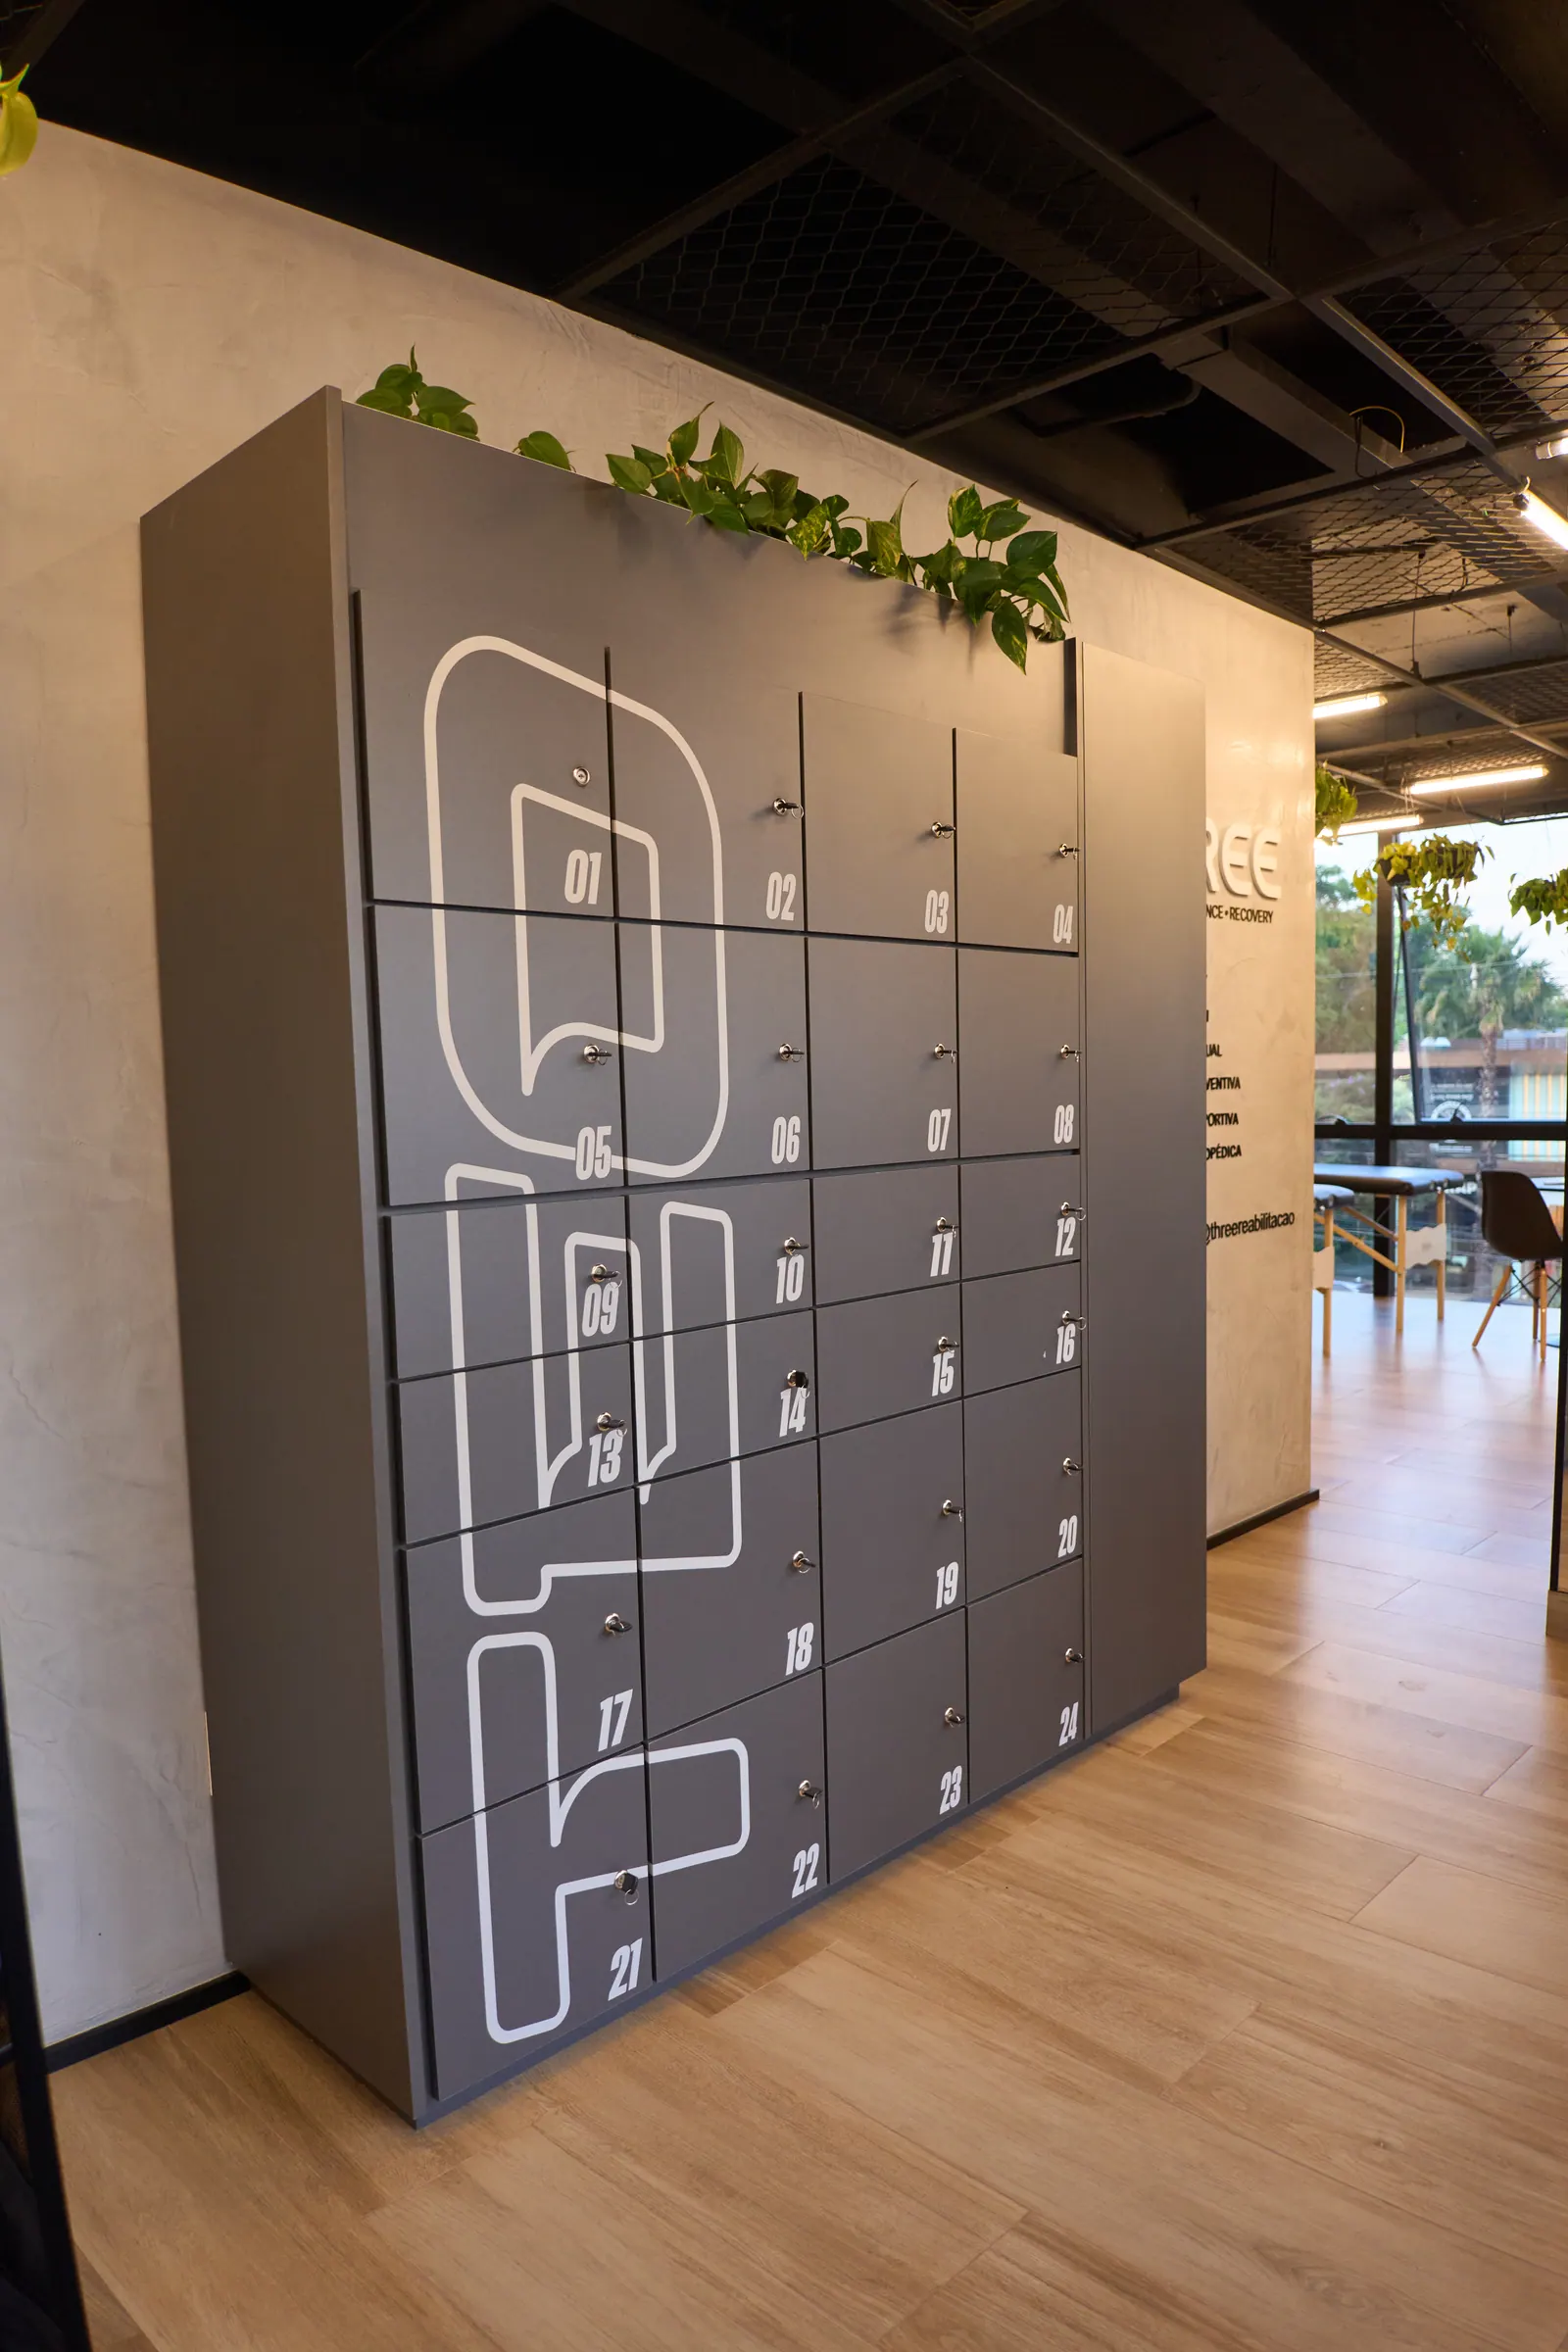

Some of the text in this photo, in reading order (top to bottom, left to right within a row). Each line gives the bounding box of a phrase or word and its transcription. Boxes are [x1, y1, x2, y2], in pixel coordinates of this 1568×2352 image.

[564, 849, 603, 906] 01
[765, 871, 797, 921] 02
[924, 889, 950, 934] 03
[1053, 904, 1074, 945] 04
[1229, 906, 1274, 923] RECOVERY
[771, 1115, 801, 1164] 06
[927, 1108, 952, 1152] 07
[1054, 1103, 1075, 1145] 08
[1206, 1112, 1240, 1127] ORTIVA
[575, 1125, 612, 1180] 05
[930, 1232, 954, 1278] 11
[1054, 1216, 1076, 1257] 12
[775, 1253, 805, 1304] 10
[581, 1281, 619, 1337] 09
[1055, 1323, 1077, 1365] 16
[931, 1349, 956, 1397] 15
[778, 1386, 808, 1438] 14
[588, 1428, 624, 1488] 13
[1057, 1514, 1078, 1558] 20
[935, 1561, 959, 1610] 19
[785, 1622, 814, 1677] 18
[597, 1688, 634, 1752] 17
[1058, 1701, 1079, 1747] 24
[939, 1765, 963, 1815] 23
[791, 1842, 820, 1899] 22
[608, 1936, 643, 2001] 21
